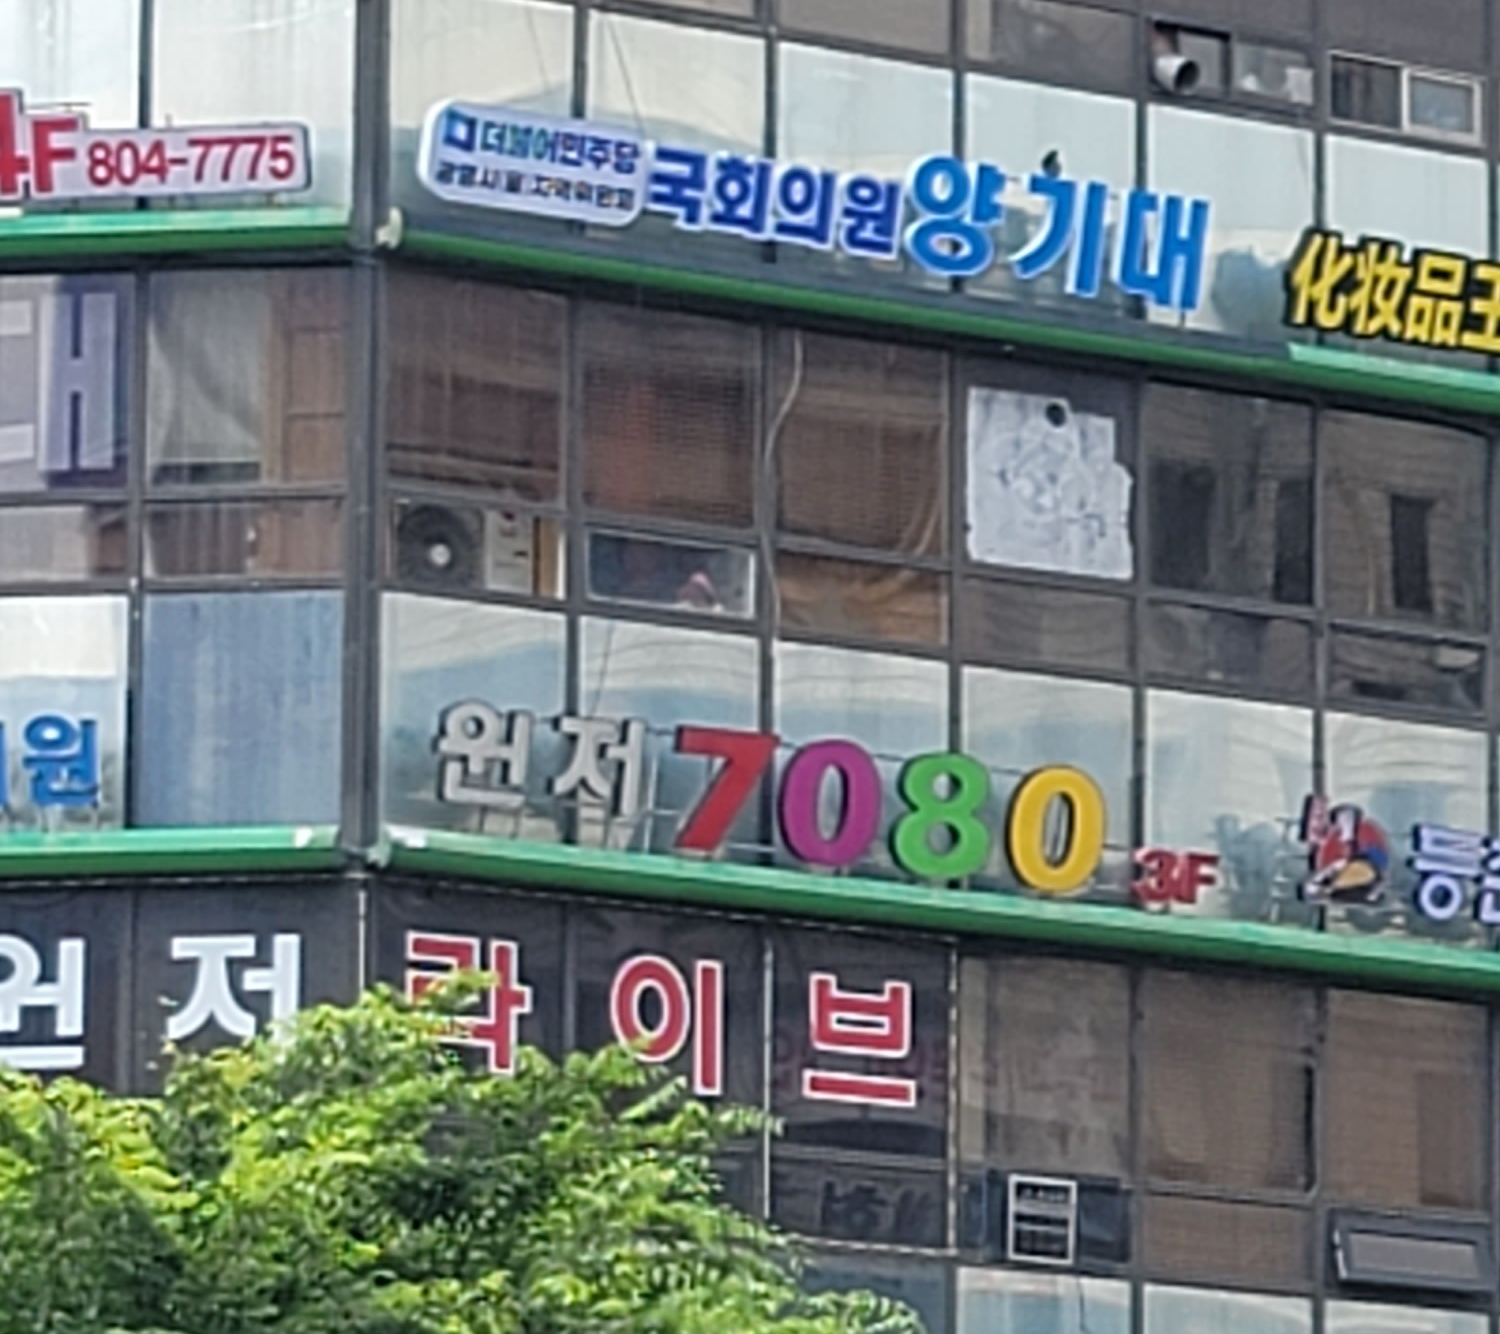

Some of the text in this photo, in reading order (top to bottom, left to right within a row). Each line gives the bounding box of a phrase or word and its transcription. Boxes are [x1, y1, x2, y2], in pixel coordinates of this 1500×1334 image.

[88, 136, 295, 185] 804-7775
[648, 148, 1210, 314] 국회의원 양기대
[440, 703, 1219, 907] 원저 7080 3F
